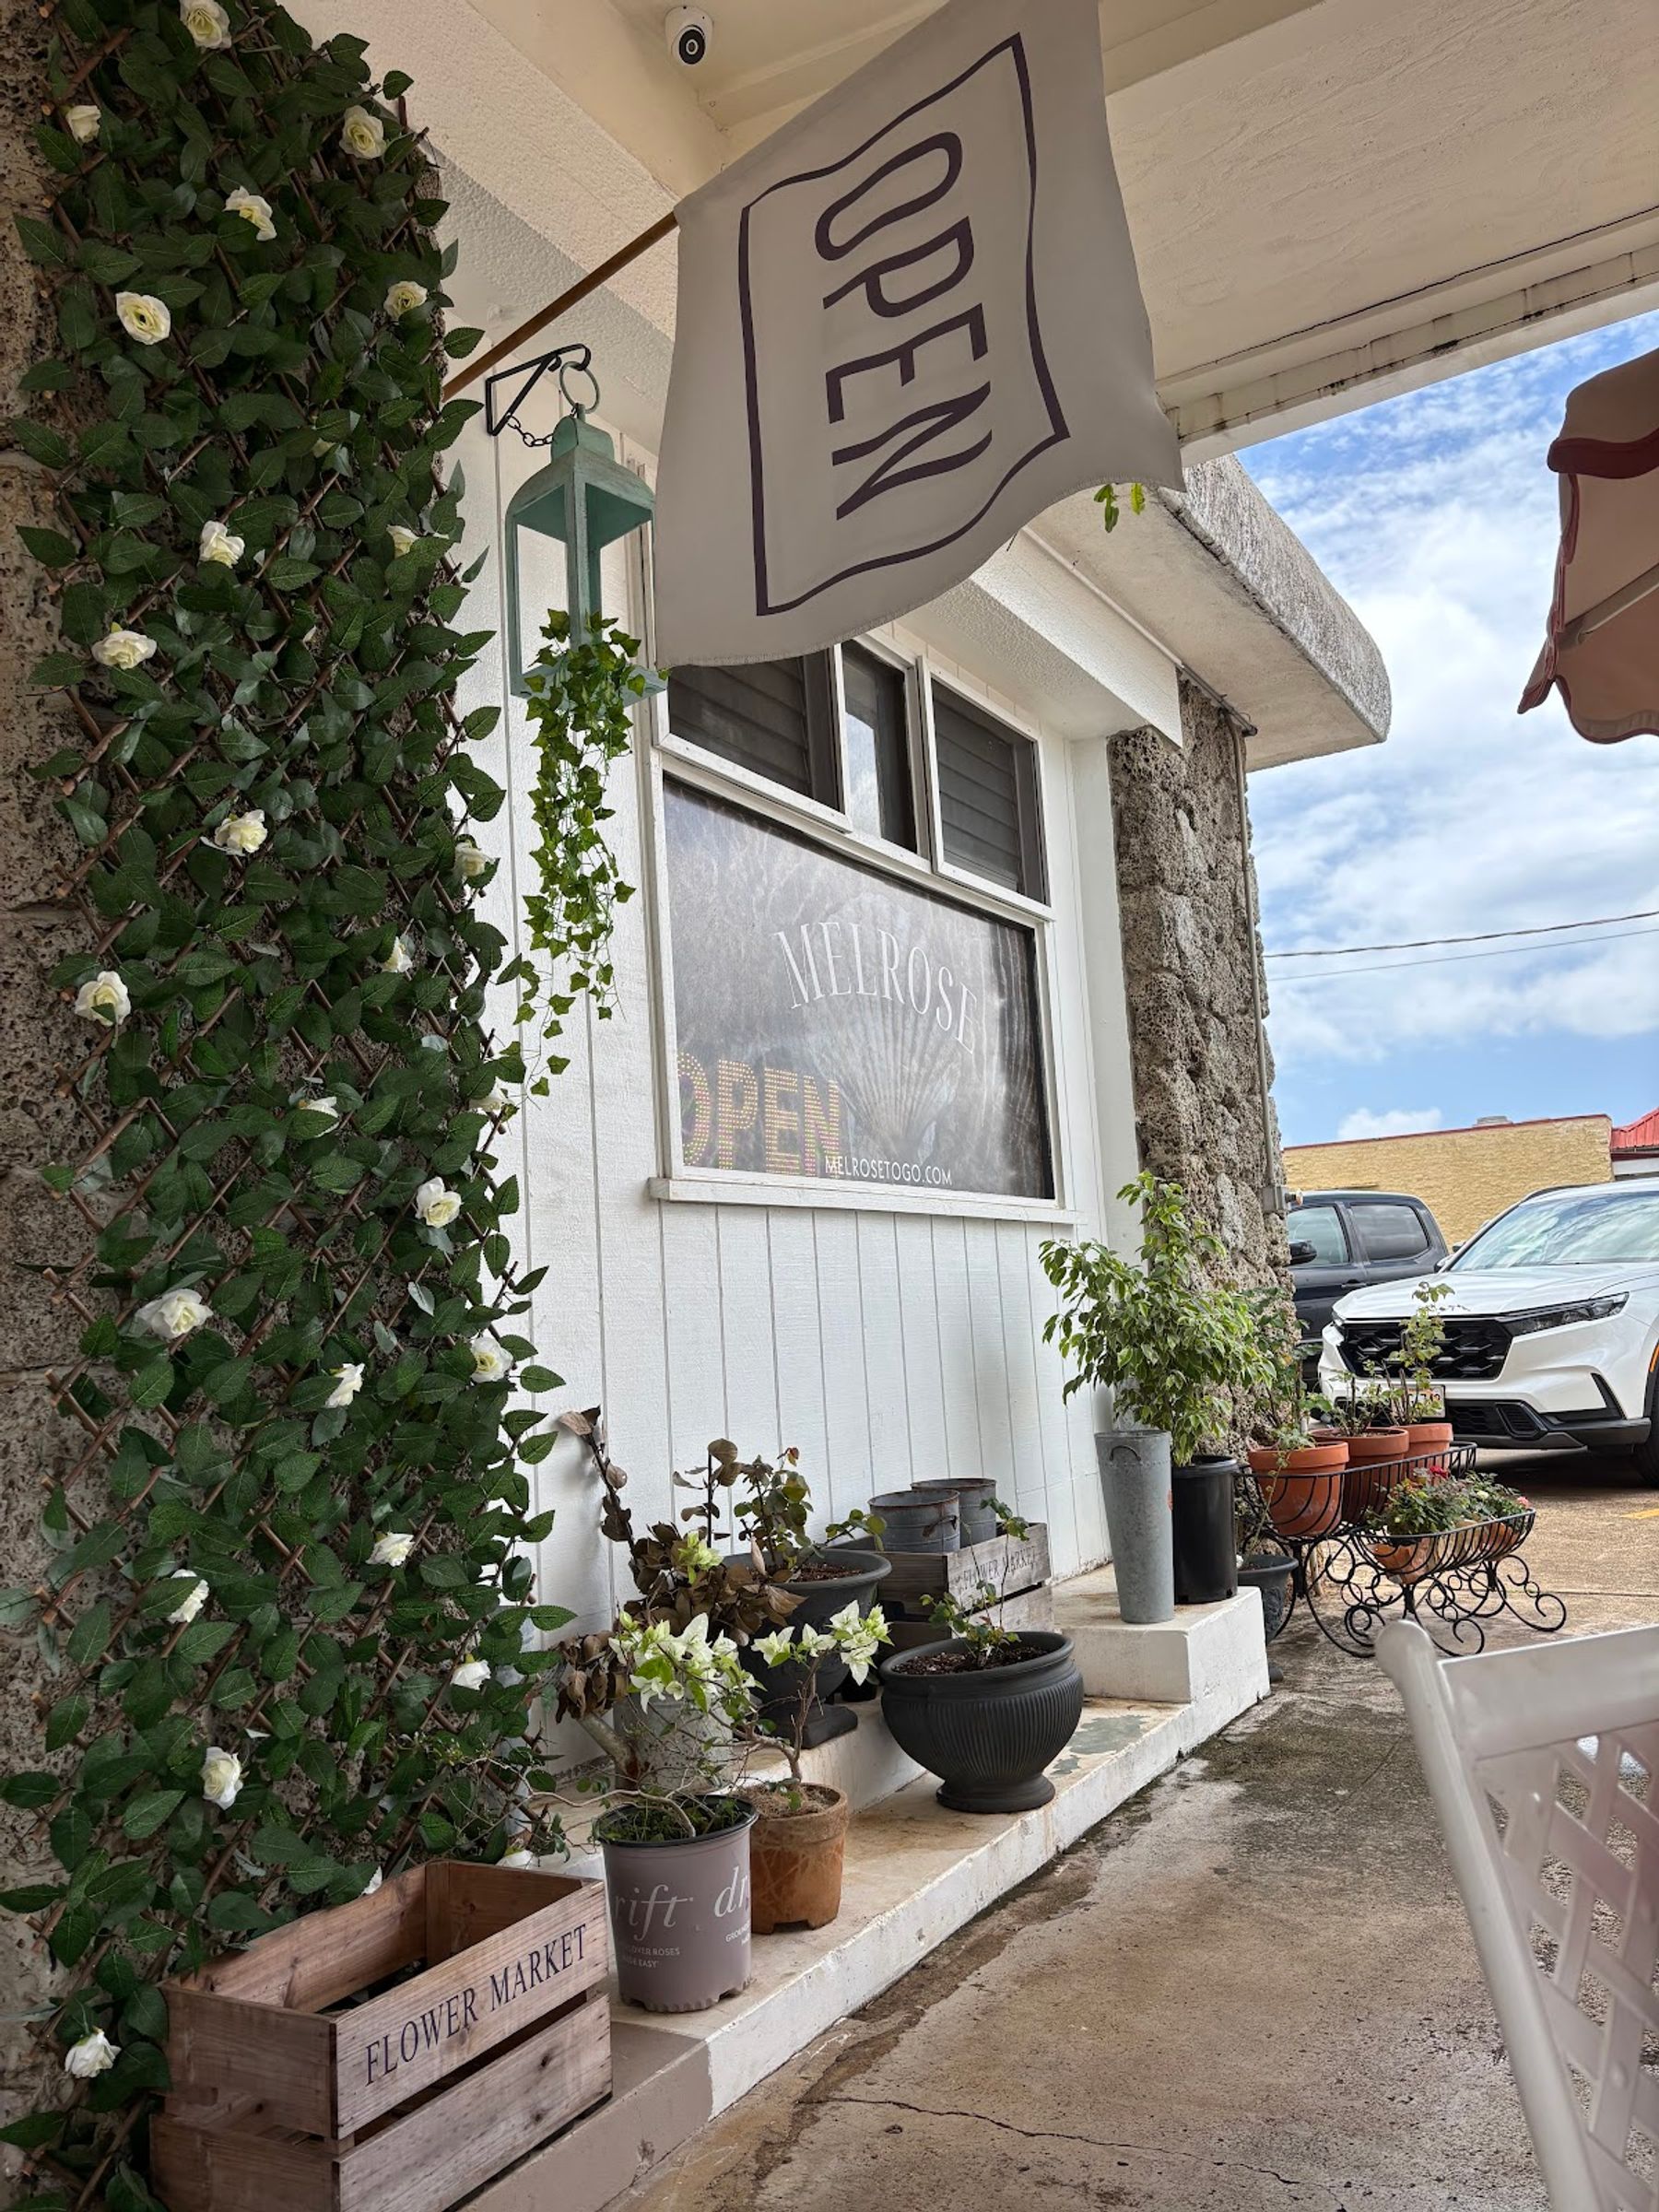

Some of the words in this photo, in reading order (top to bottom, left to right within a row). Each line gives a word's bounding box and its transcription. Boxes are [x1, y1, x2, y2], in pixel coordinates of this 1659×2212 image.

[815, 131, 993, 521] OPEN
[771, 922, 978, 1054] MELROSE
[825, 1155, 953, 1185] MELROSETOGO.COM
[615, 1884, 688, 1941] rift
[365, 1987, 479, 2088] FLOWER
[489, 1924, 587, 2012] MARKET
